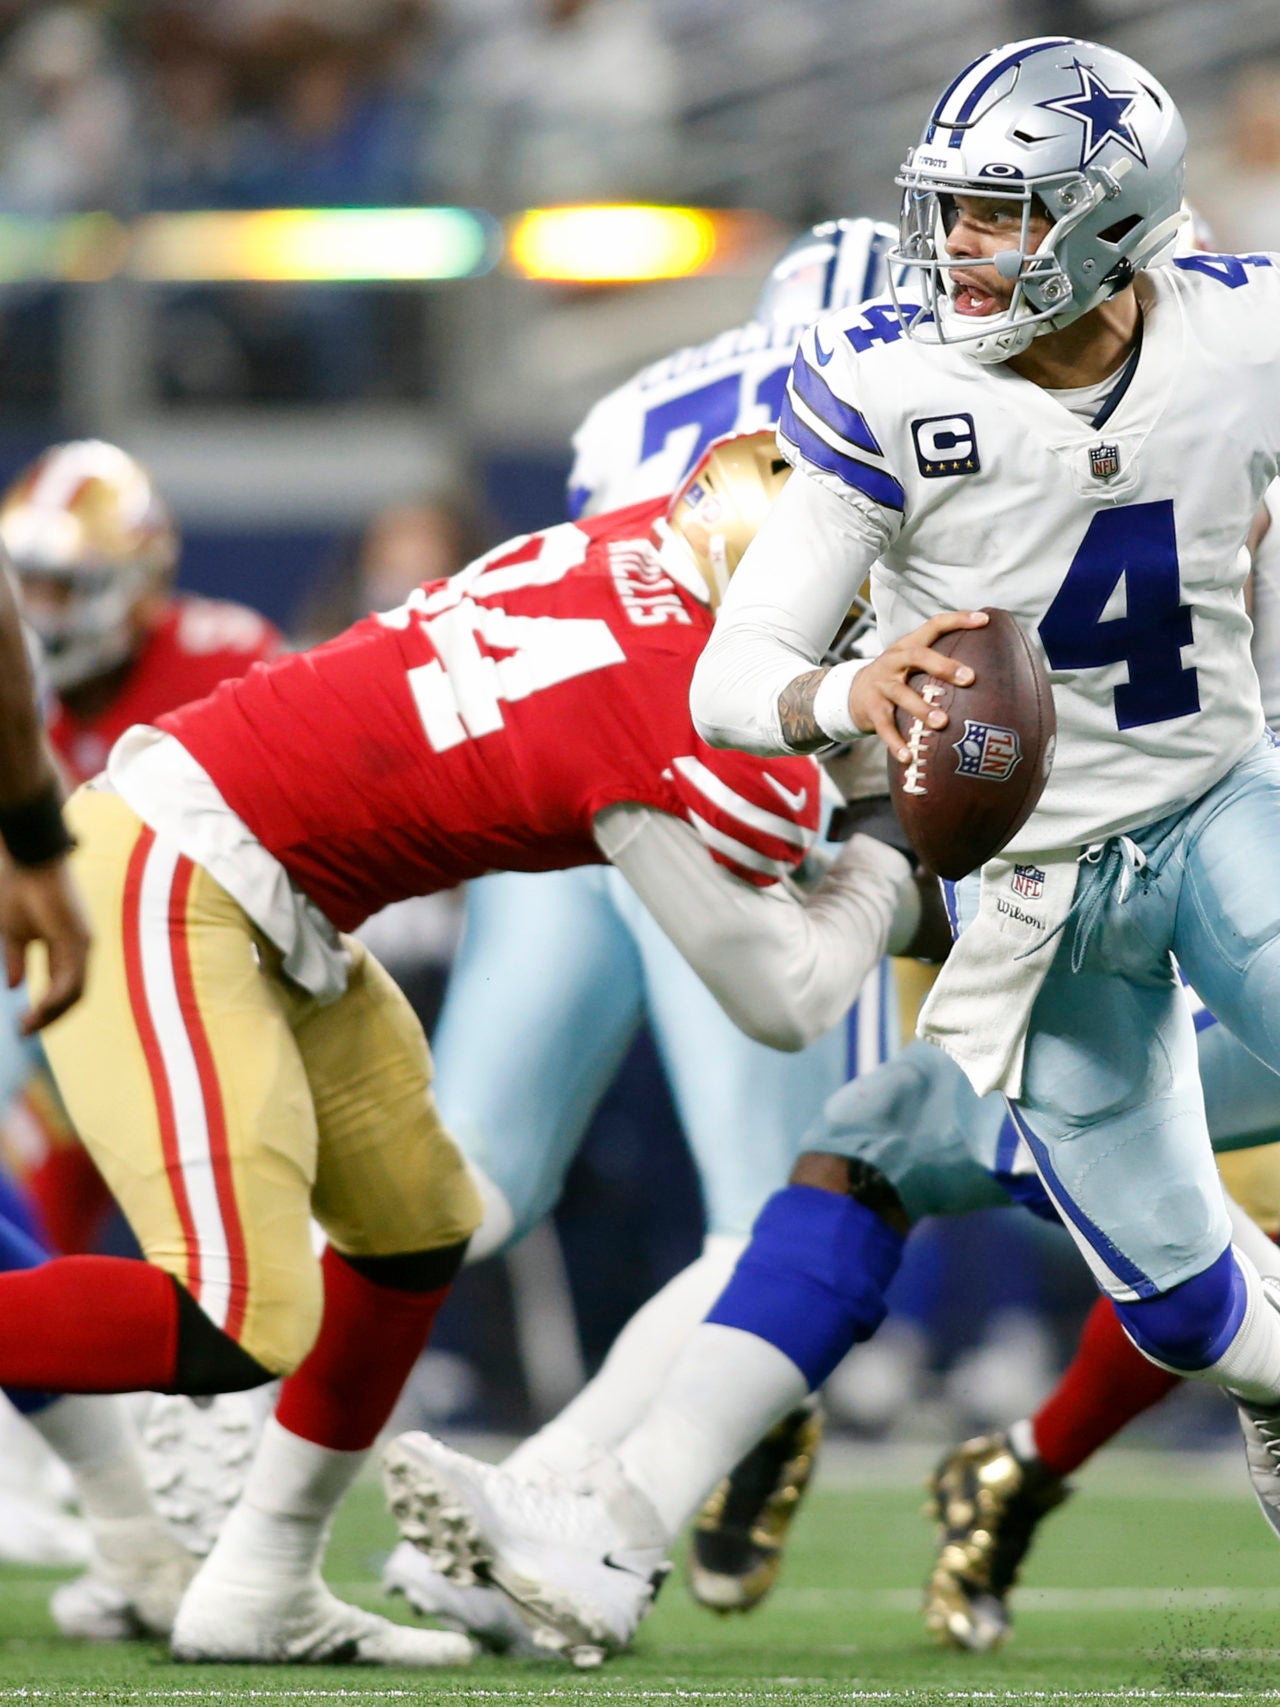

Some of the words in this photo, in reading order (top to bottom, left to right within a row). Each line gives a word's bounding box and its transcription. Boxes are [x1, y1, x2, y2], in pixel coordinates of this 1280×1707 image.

[1173, 255, 1273, 290] 4
[843, 304, 935, 353] 4
[917, 417, 973, 462] C
[1094, 460, 1116, 474] NFL
[1037, 498, 1202, 731] 4
[981, 734, 1015, 774] NFL
[1014, 875, 1041, 897] NFL
[997, 897, 1041, 929] Wilson
